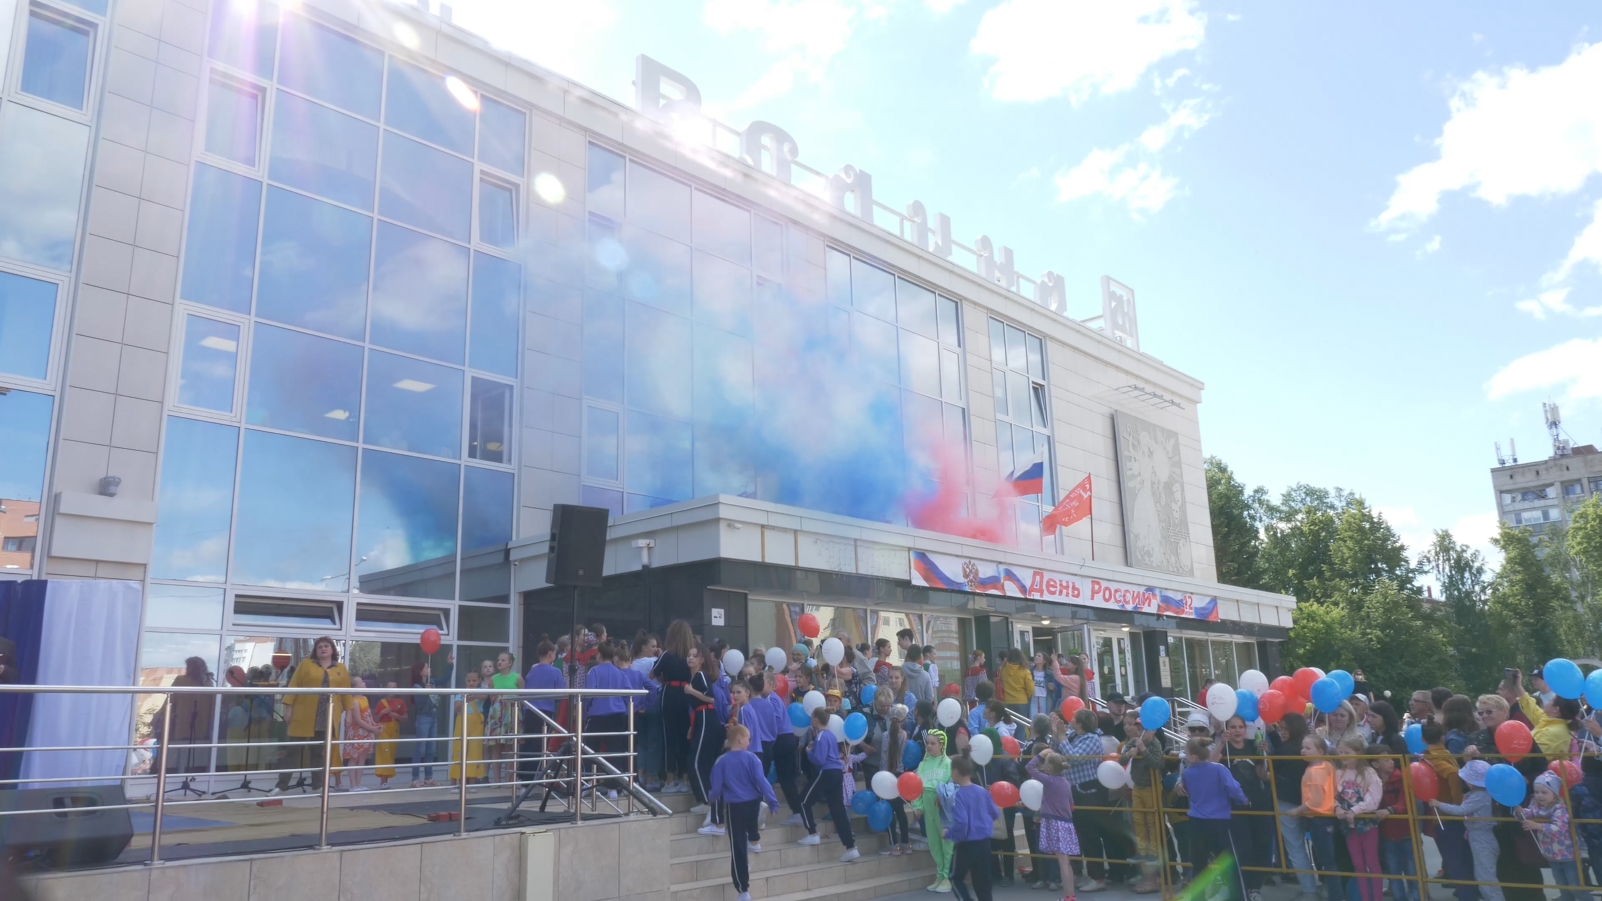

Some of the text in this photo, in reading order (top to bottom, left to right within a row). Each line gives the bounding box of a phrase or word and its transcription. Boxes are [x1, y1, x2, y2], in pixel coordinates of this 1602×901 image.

[1028, 571, 1153, 608] День России
[1183, 594, 1193, 610] 12
